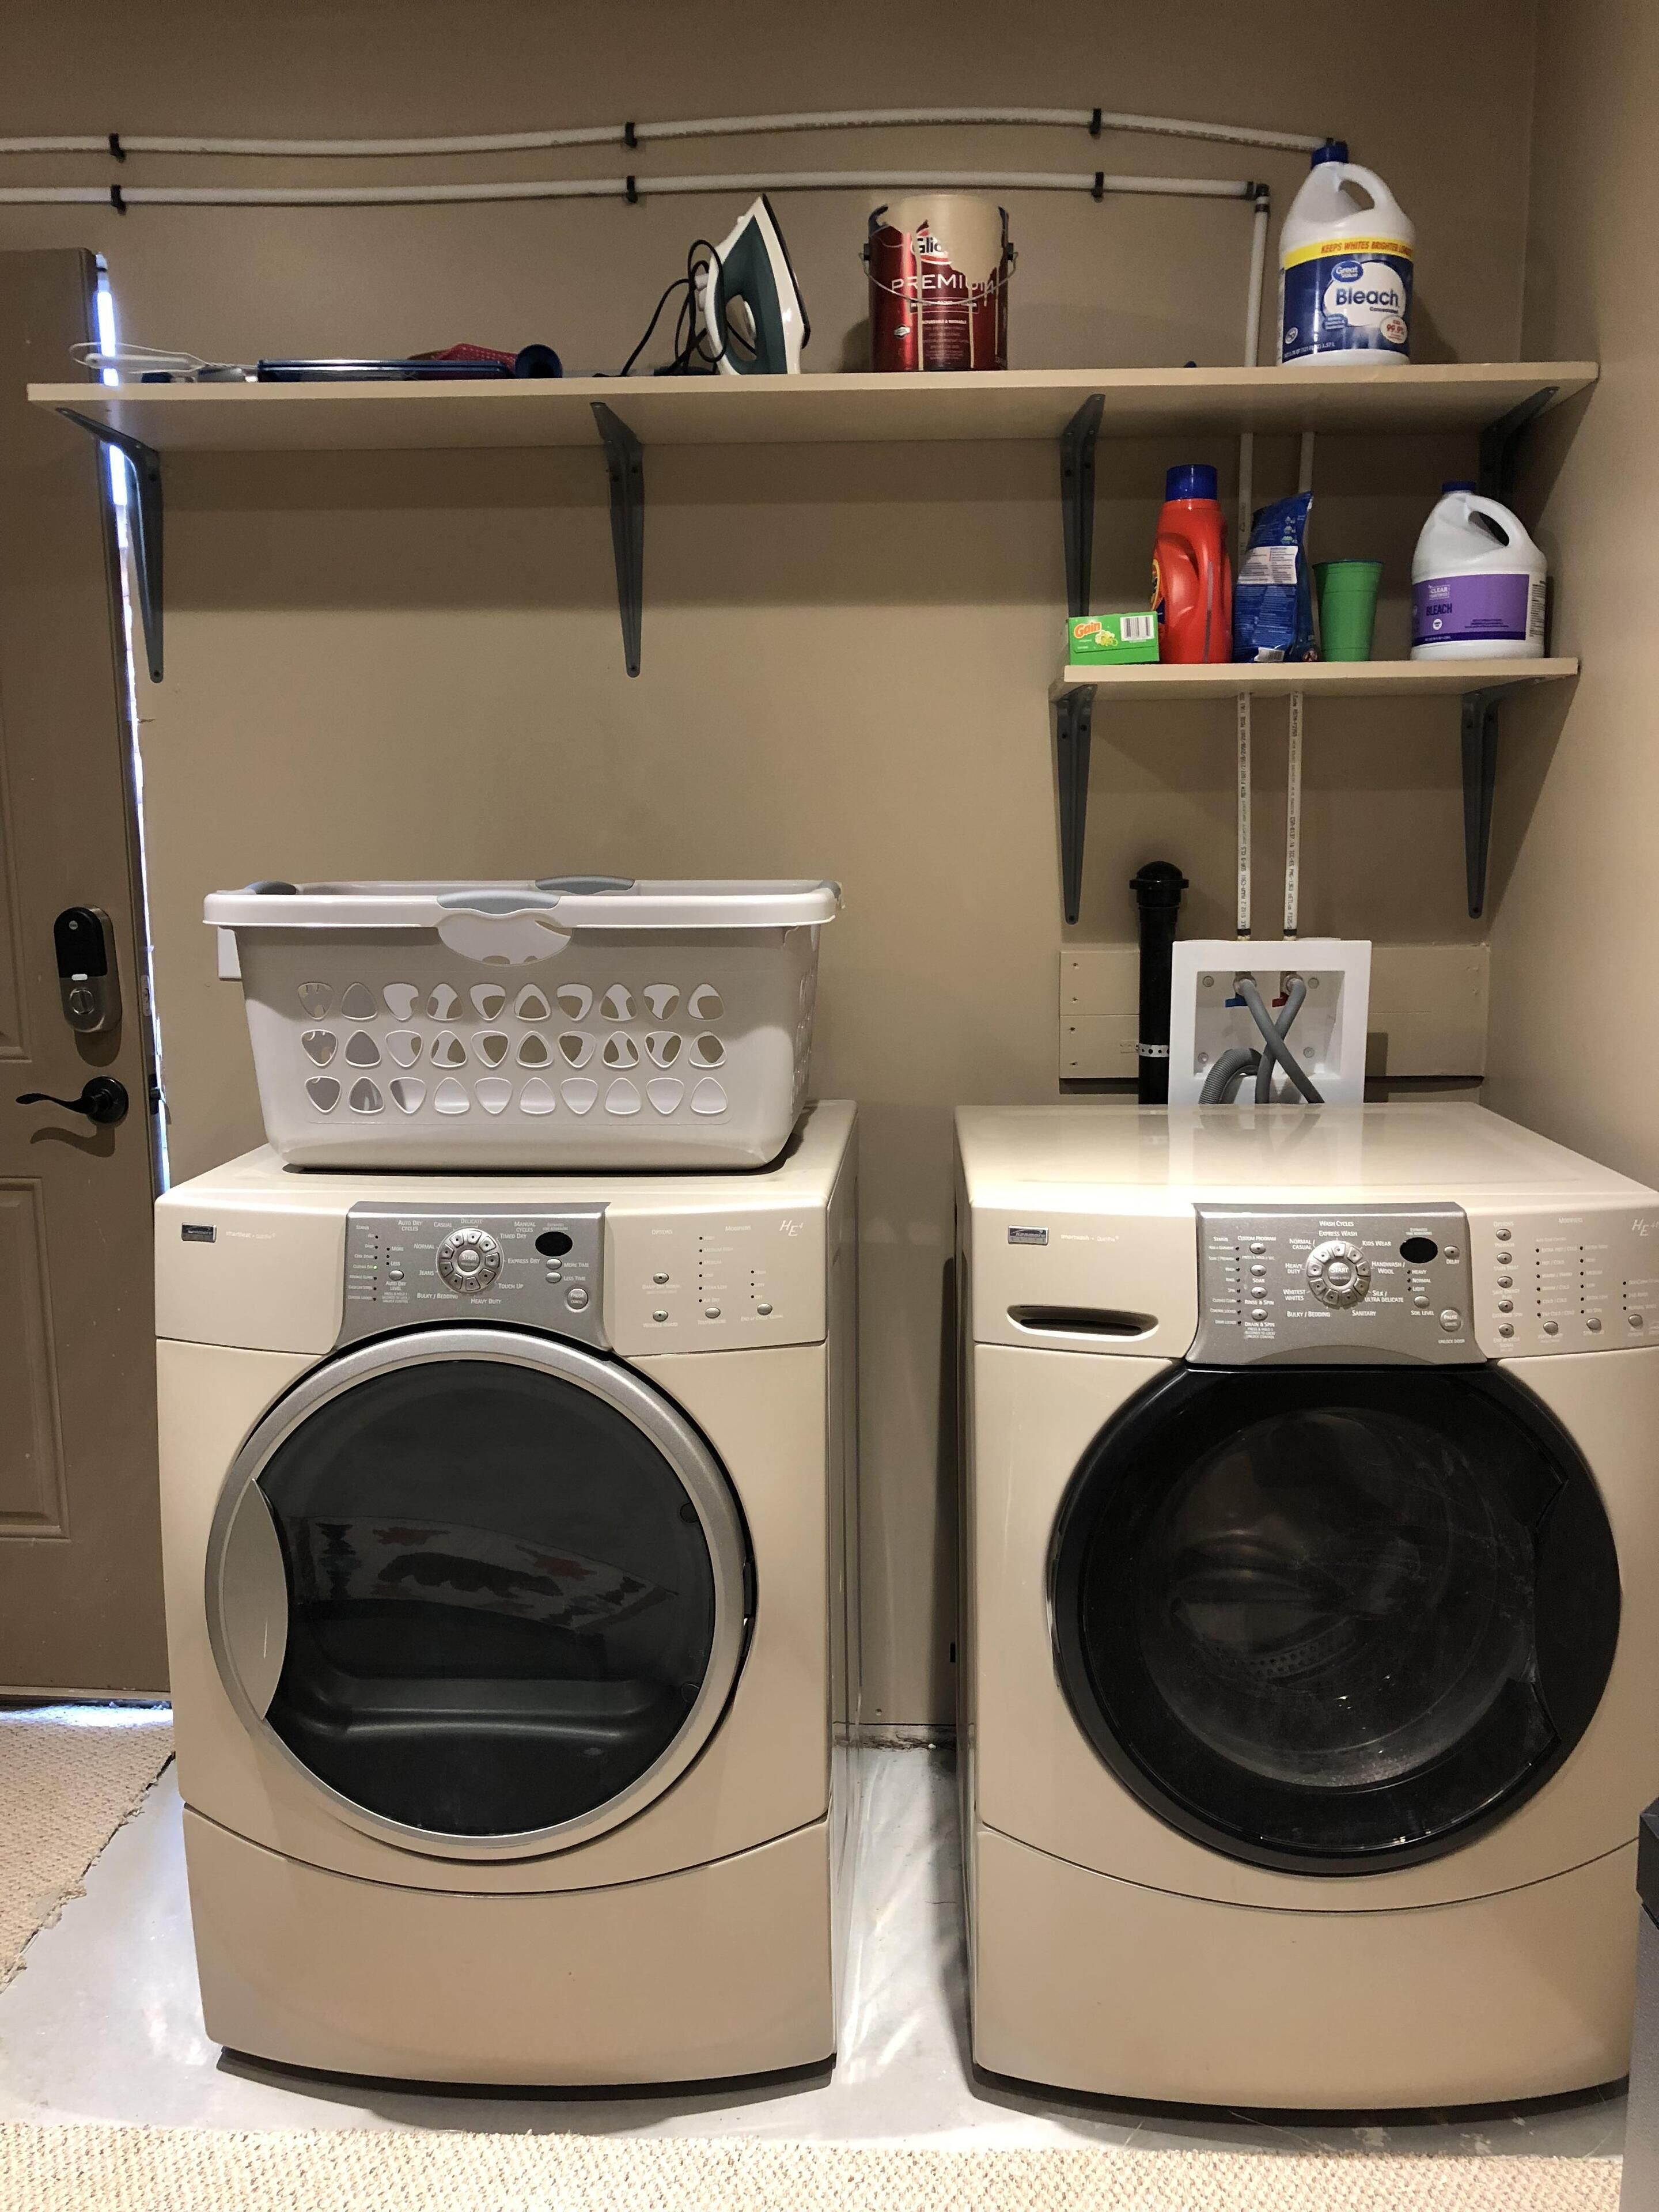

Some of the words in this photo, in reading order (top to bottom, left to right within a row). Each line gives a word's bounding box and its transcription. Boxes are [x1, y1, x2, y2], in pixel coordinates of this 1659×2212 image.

[1321, 243, 1342, 253] KEEPS
[1344, 241, 1369, 250] WHITES
[1372, 241, 1398, 251] BRIGHTER
[1336, 288, 1399, 306] Bleach
[1426, 603, 1452, 616] BLEACH
[1074, 622, 1101, 638] Gain
